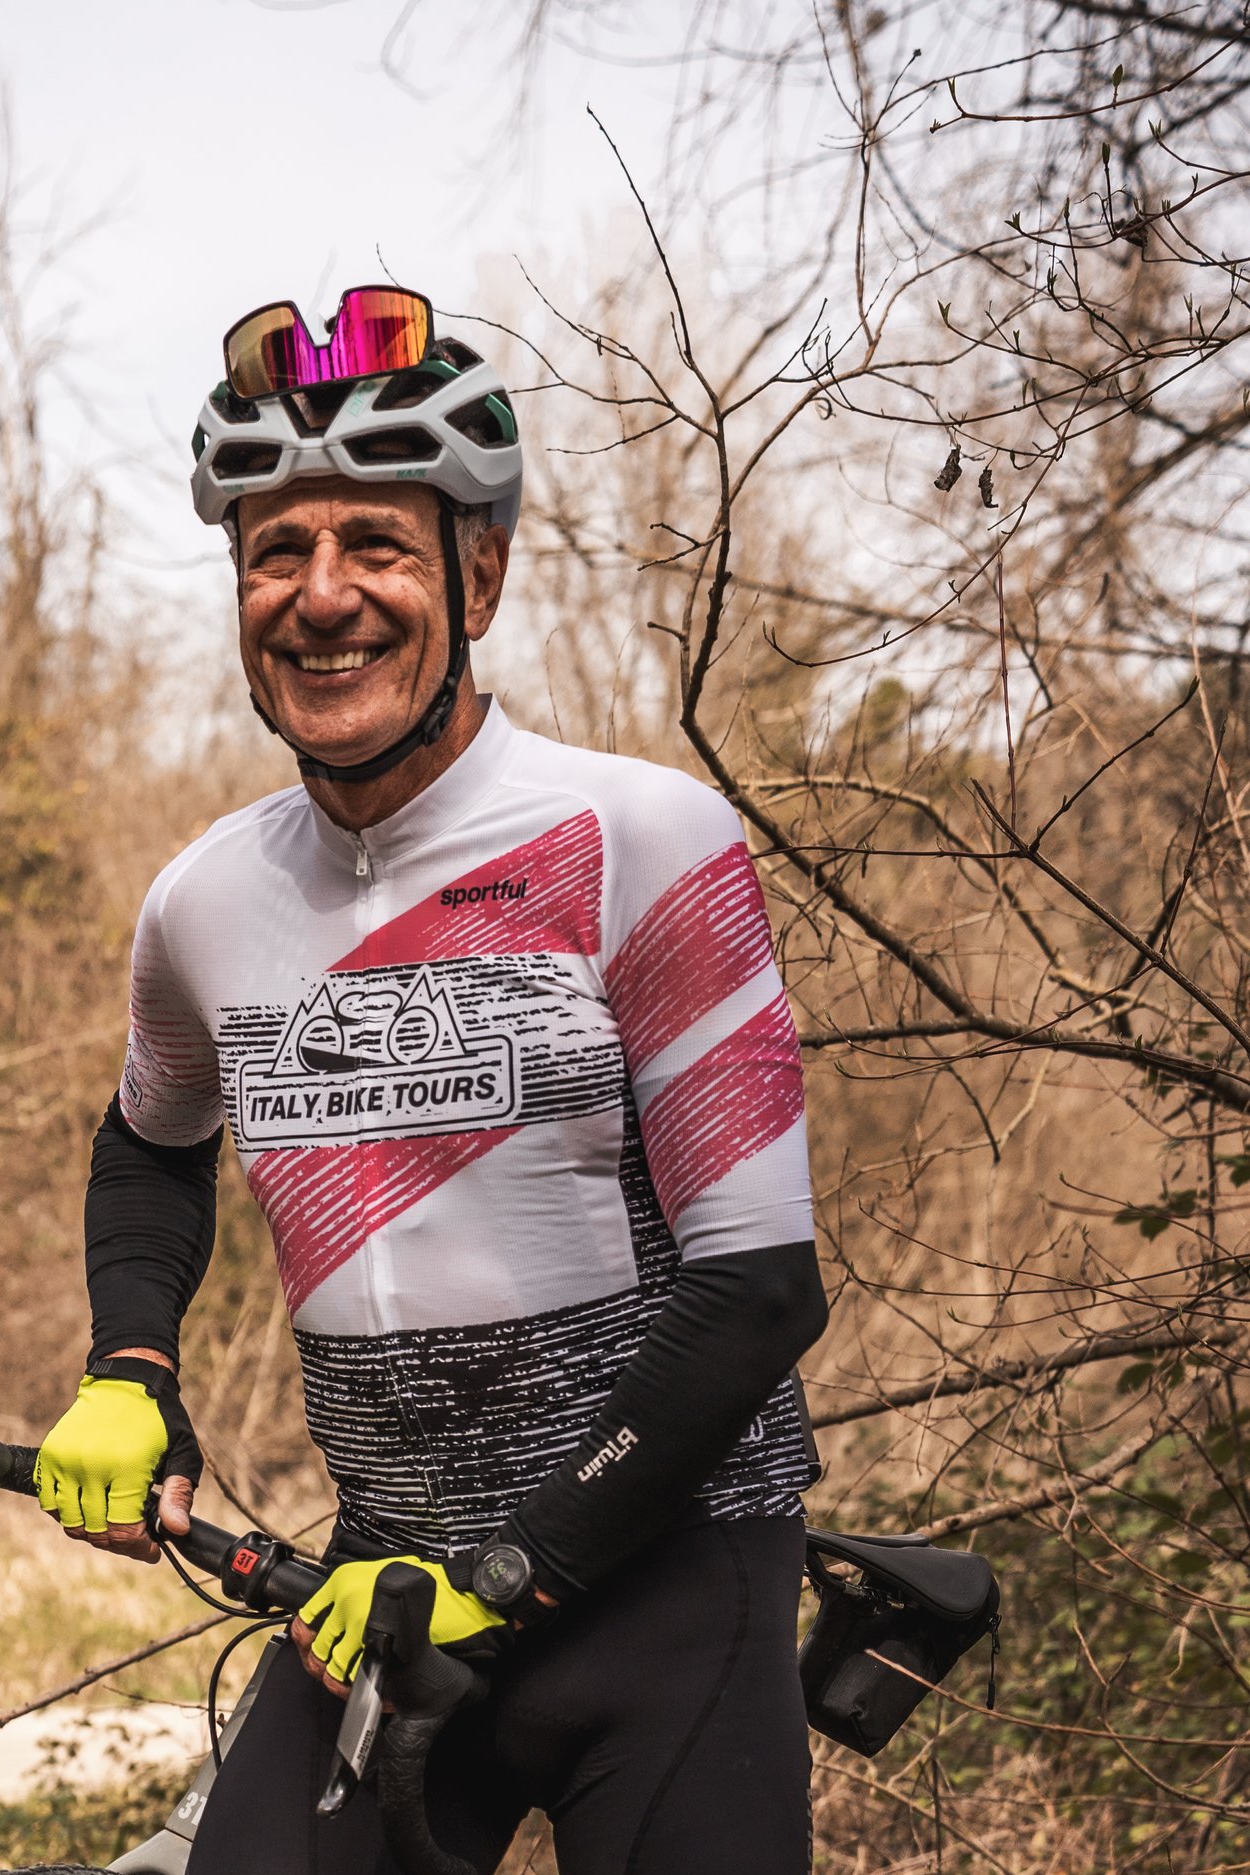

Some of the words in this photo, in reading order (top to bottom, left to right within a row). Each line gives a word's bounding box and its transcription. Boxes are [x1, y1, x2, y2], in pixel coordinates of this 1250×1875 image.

[440, 878, 528, 910] sportful
[250, 1092, 321, 1122] ITALY
[326, 1085, 385, 1118] BIKE
[393, 1072, 498, 1109] TOURS
[237, 1552, 254, 1569] 3T
